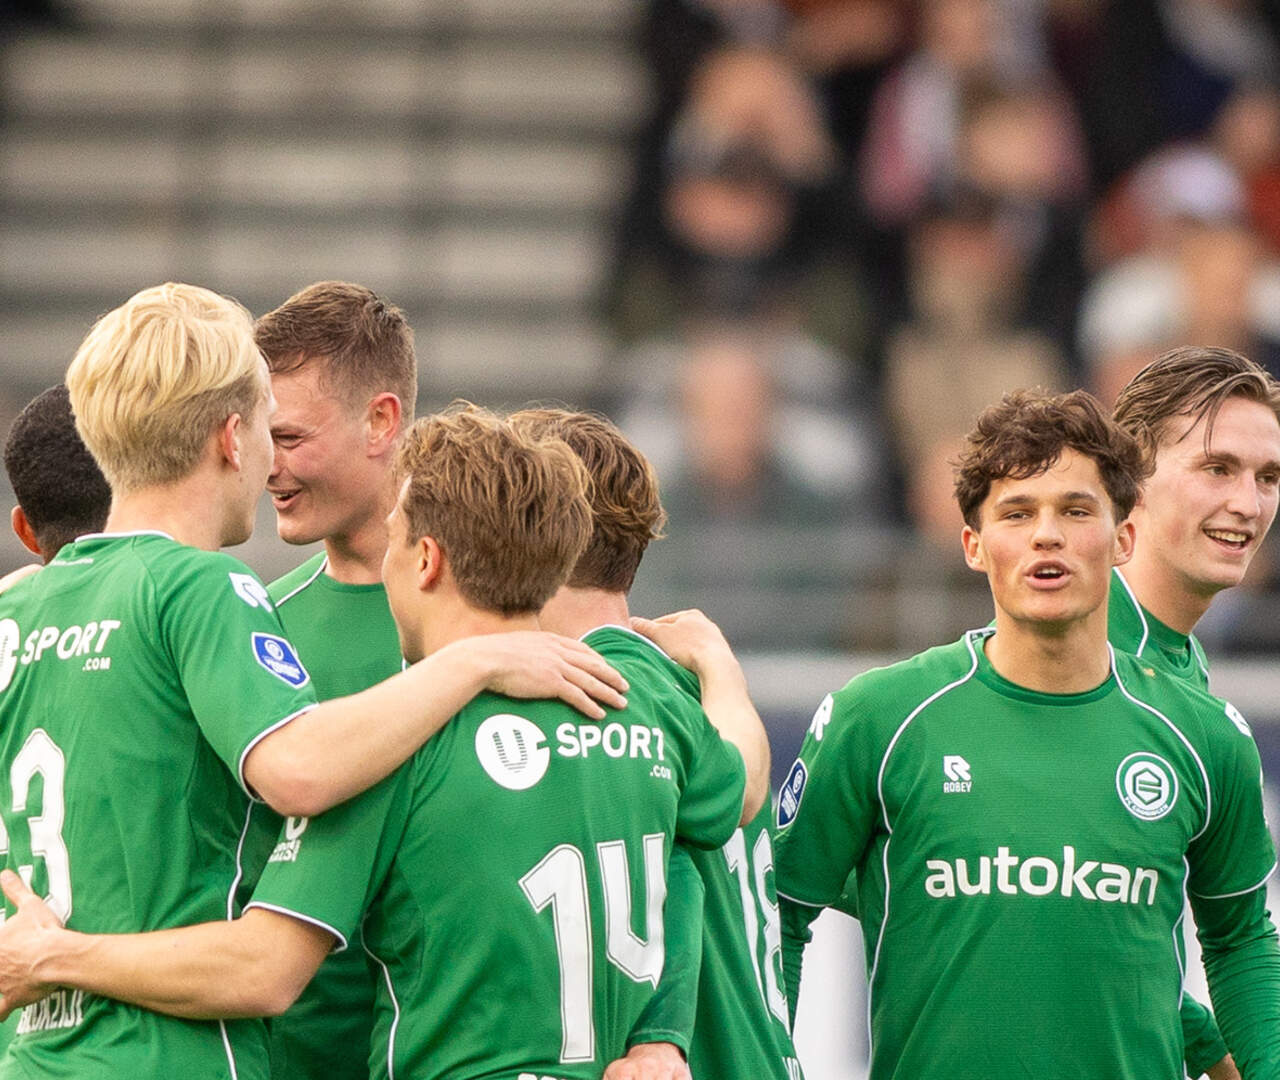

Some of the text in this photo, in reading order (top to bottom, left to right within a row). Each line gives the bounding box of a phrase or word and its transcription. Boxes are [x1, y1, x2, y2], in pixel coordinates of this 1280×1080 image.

[21, 619, 121, 664] SPORT
[82, 657, 111, 671] .COM
[555, 722, 665, 761] SPORT
[943, 781, 972, 793] ROBEY
[924, 845, 1159, 906] autokan
[518, 832, 668, 1064] 14
